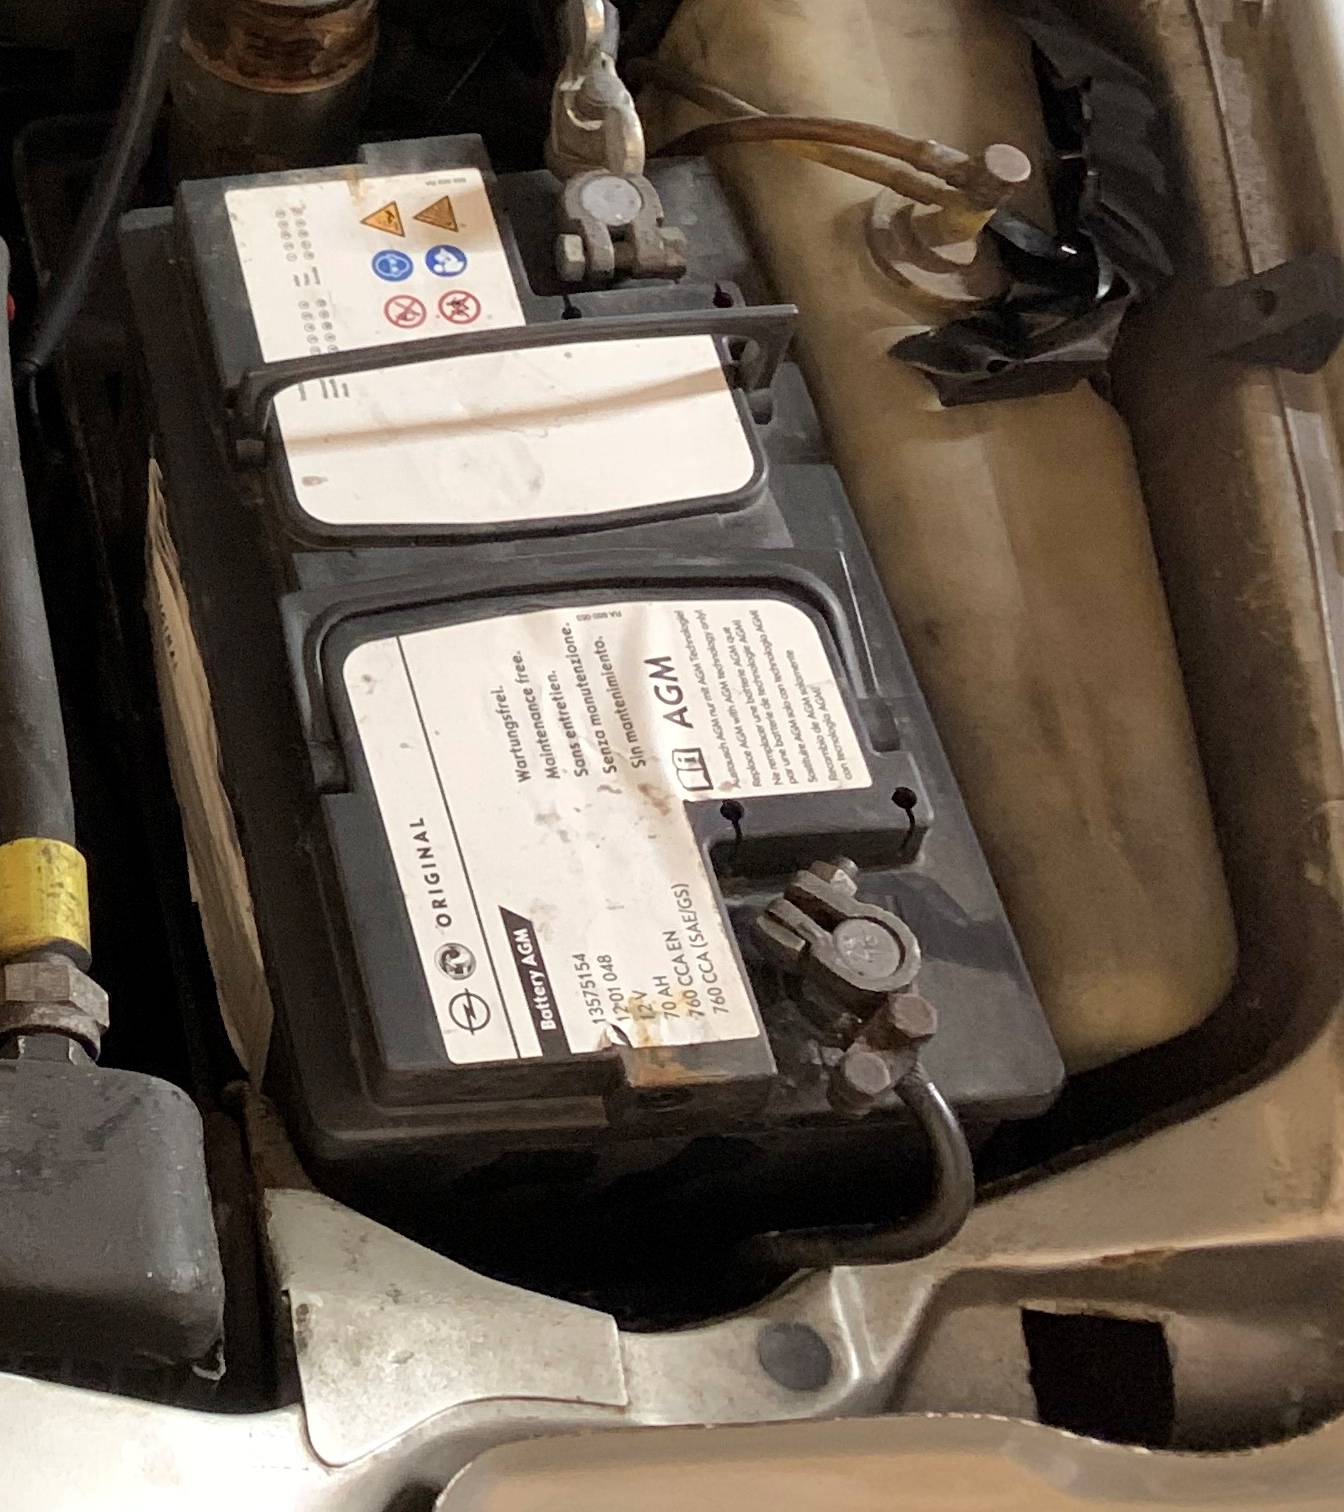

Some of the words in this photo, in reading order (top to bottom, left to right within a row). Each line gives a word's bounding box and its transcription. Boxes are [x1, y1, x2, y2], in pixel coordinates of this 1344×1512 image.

[513, 651, 529, 684] free.
[562, 623, 601, 726] manutenzione.
[548, 671, 577, 739] entretien.
[594, 636, 638, 743] mantenimiento.
[644, 656, 694, 729] AGM
[491, 686, 531, 782] Wartungsfrei.
[523, 688, 560, 779] Maintenance
[569, 741, 588, 777] Sans
[595, 730, 617, 774] Senza
[630, 746, 646, 768] Sin
[410, 817, 452, 928] ORIGINAL
[671, 884, 708, 948] (SAE/GS)
[514, 928, 538, 967] AGM
[663, 931, 682, 951] EN
[597, 955, 617, 981] 048
[672, 954, 693, 986] CCA
[696, 951, 717, 983] CCA
[529, 970, 557, 1030] Battery
[572, 954, 607, 1025] 13575154
[632, 990, 647, 1001] V
[653, 976, 673, 997] AH
[682, 990, 705, 1018] 760
[707, 987, 729, 1014] 760
[637, 1002, 656, 1020] 12
[661, 1001, 680, 1020] 70
